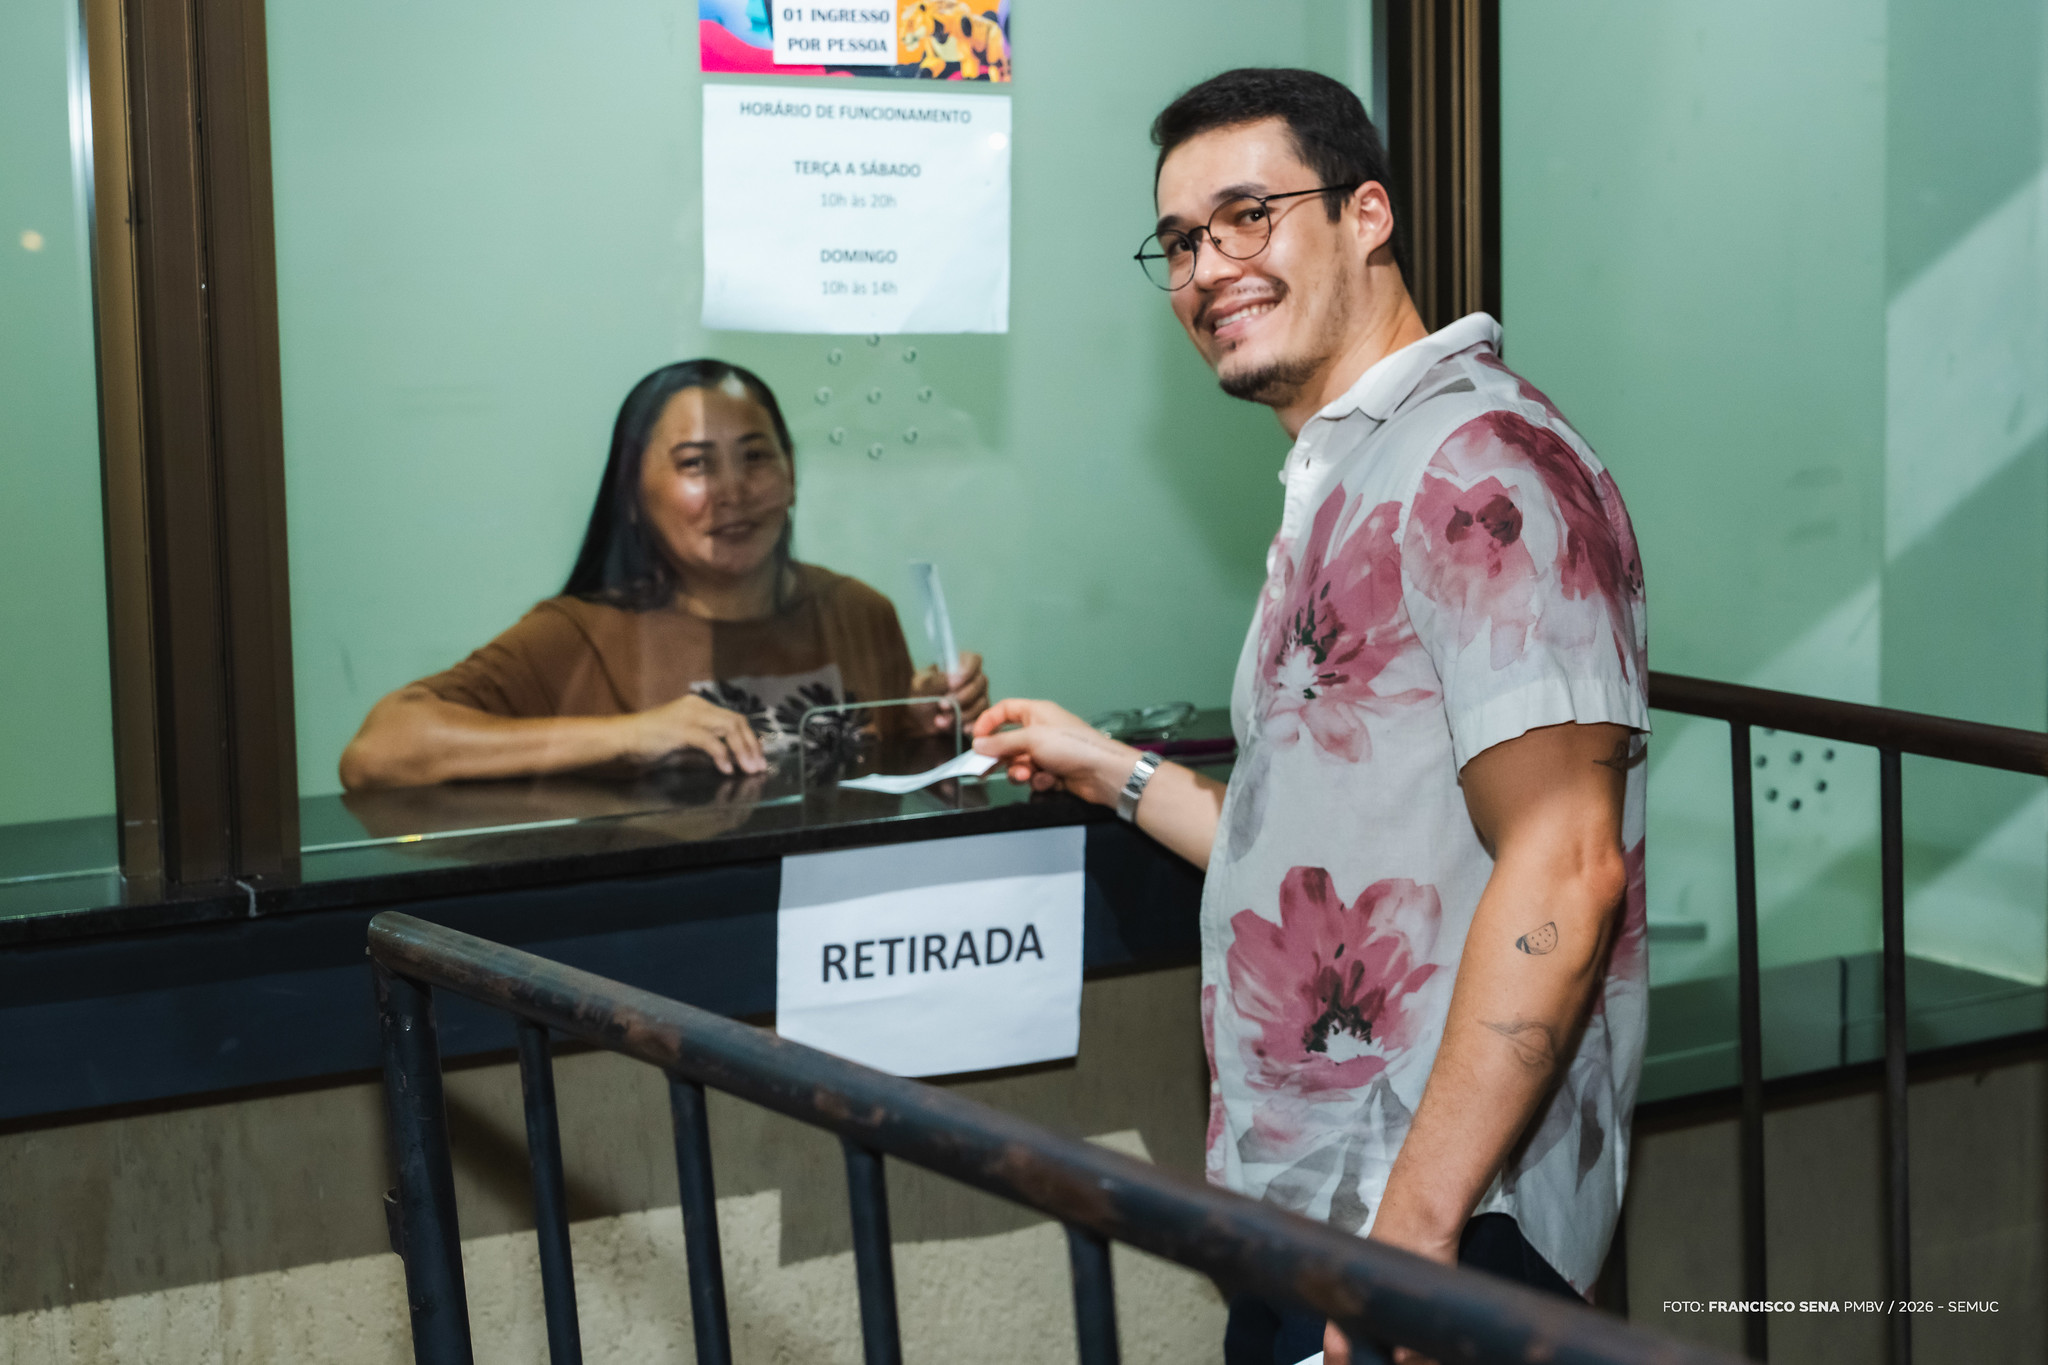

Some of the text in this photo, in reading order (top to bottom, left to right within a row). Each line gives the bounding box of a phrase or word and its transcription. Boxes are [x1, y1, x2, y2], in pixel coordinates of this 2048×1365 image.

[783, 8, 891, 24] 01 INGRESSO
[787, 37, 888, 52] POR PESSOA
[739, 101, 972, 124] HORÁRIO DE FUNCIONAMENTO
[794, 160, 921, 178] TERÇA A SÁBADO
[820, 249, 898, 264] DOMINGO
[822, 923, 1045, 983] RETIRADA
